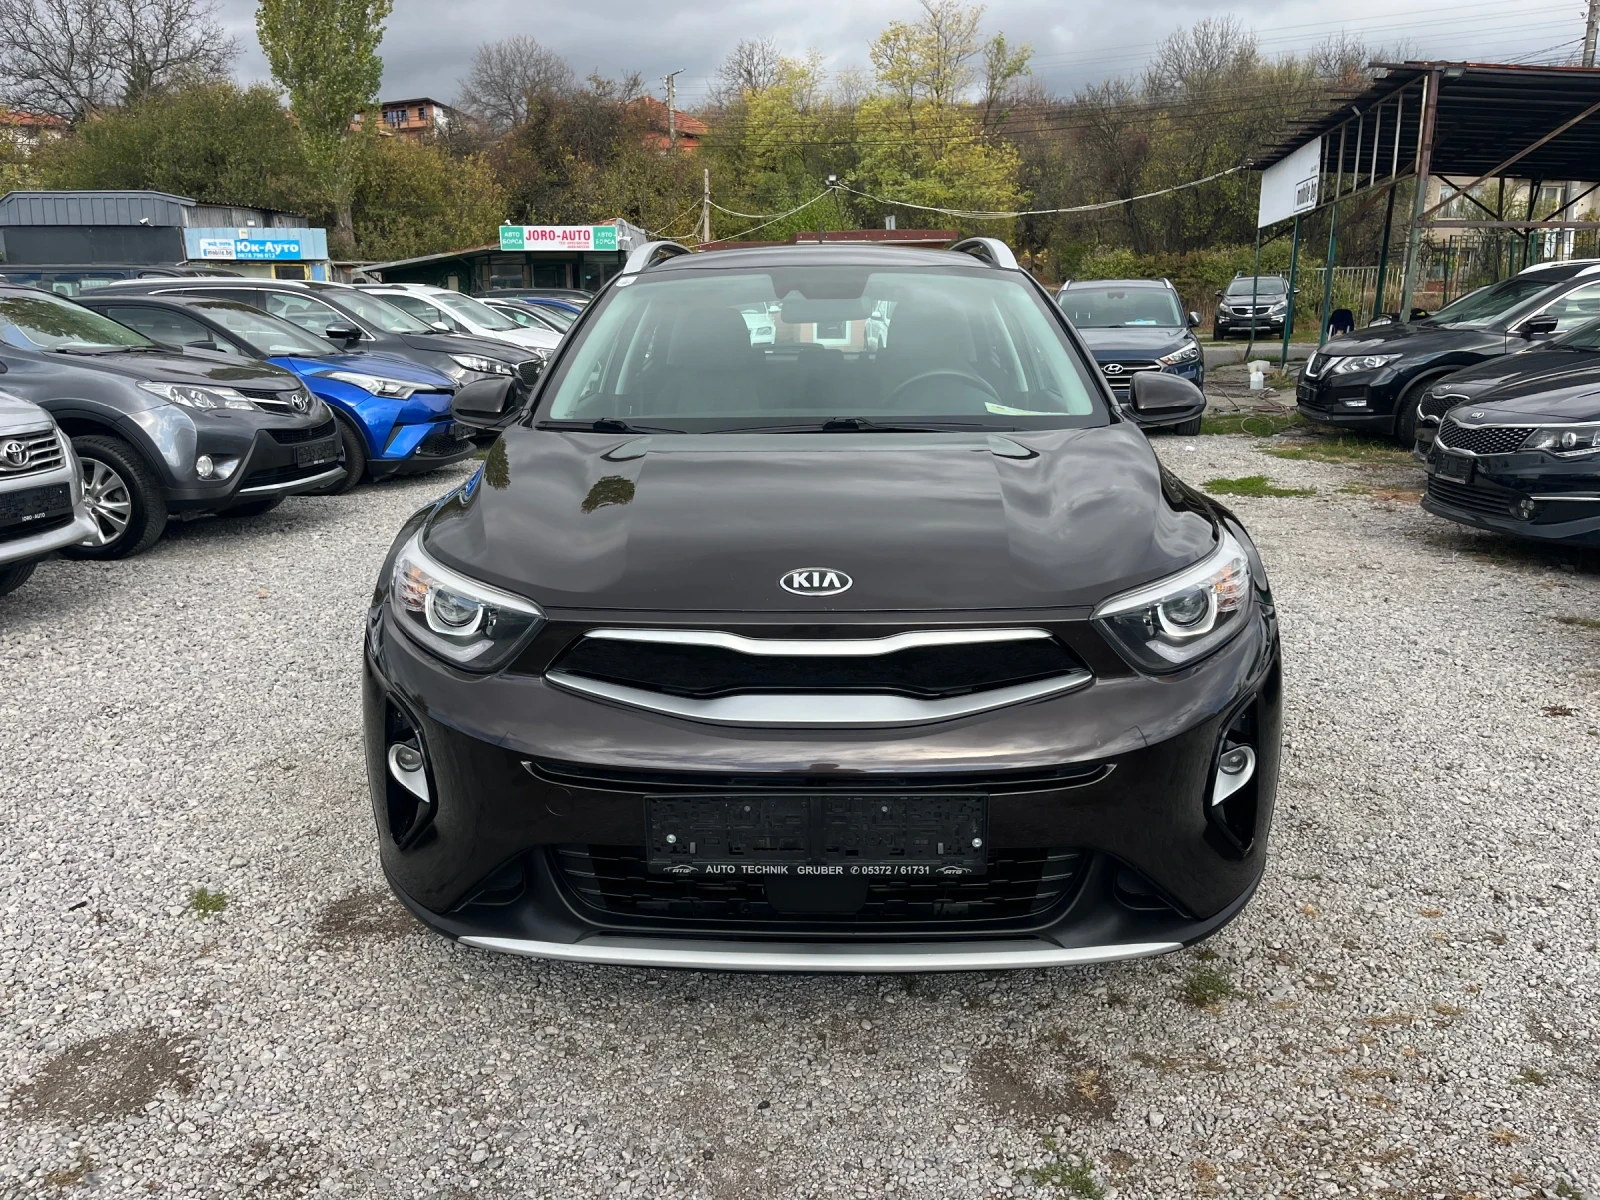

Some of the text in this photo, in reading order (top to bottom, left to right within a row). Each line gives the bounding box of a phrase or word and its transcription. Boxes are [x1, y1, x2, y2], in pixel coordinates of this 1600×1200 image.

[525, 229, 591, 241] JORO-AUTO
[236, 241, 299, 255] Юк-Ауто
[792, 571, 842, 588] KIA
[705, 865, 736, 874] AUTO
[741, 865, 788, 874] TECHNIK
[797, 865, 843, 875] GRUBER
[861, 865, 892, 875] 05372
[900, 865, 930, 875] 61731
